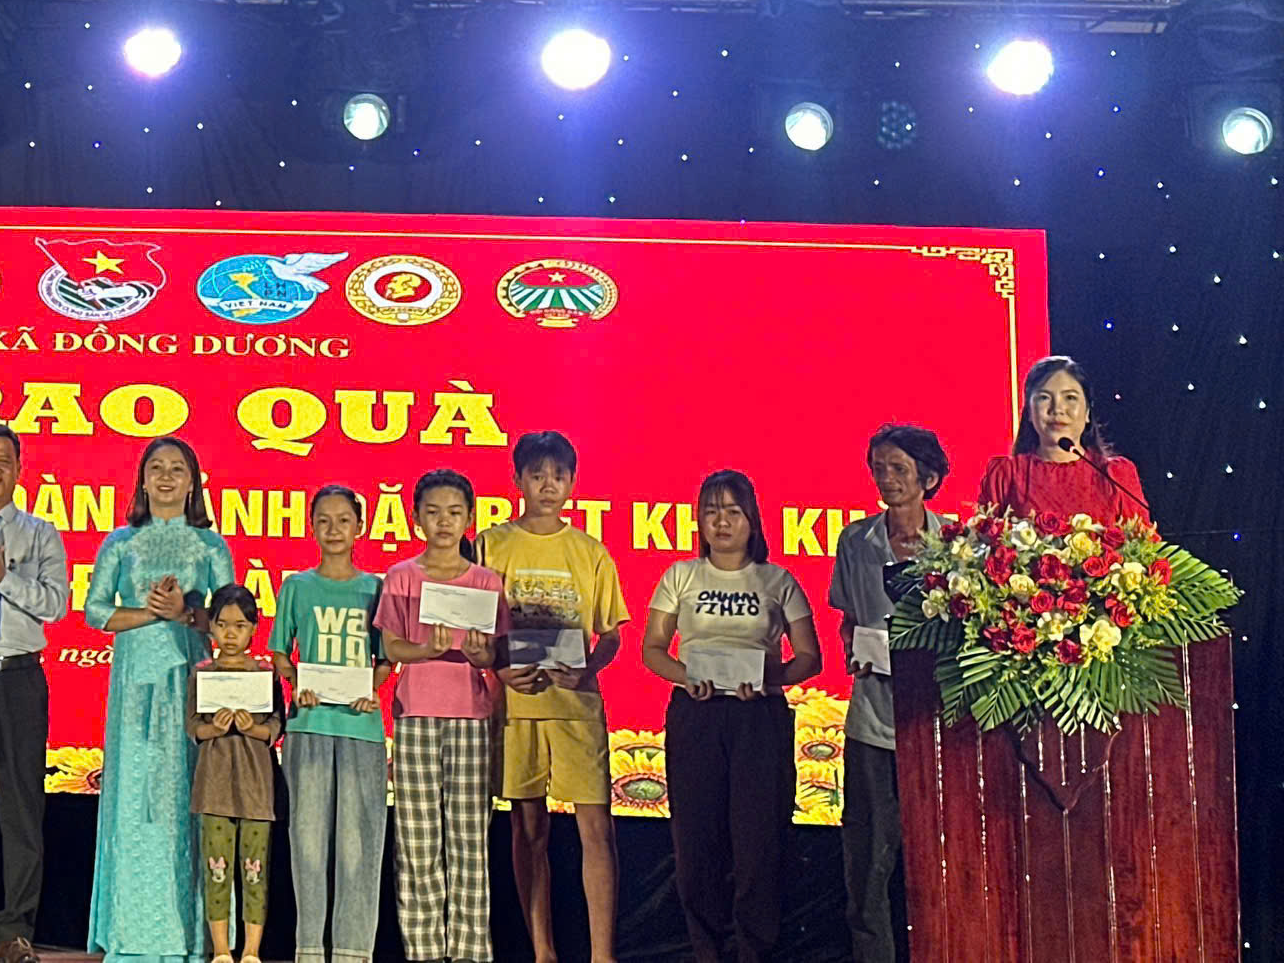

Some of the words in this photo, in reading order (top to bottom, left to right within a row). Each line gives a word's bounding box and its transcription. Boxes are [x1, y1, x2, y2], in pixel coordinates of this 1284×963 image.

[259, 301, 287, 309] NAM
[53, 323, 179, 354] ĐỒNG
[192, 333, 351, 359] DƯƠNG
[236, 380, 508, 456] QUÀ
[475, 496, 611, 542] BT
[313, 606, 369, 637] wa
[59, 646, 113, 667] ngà
